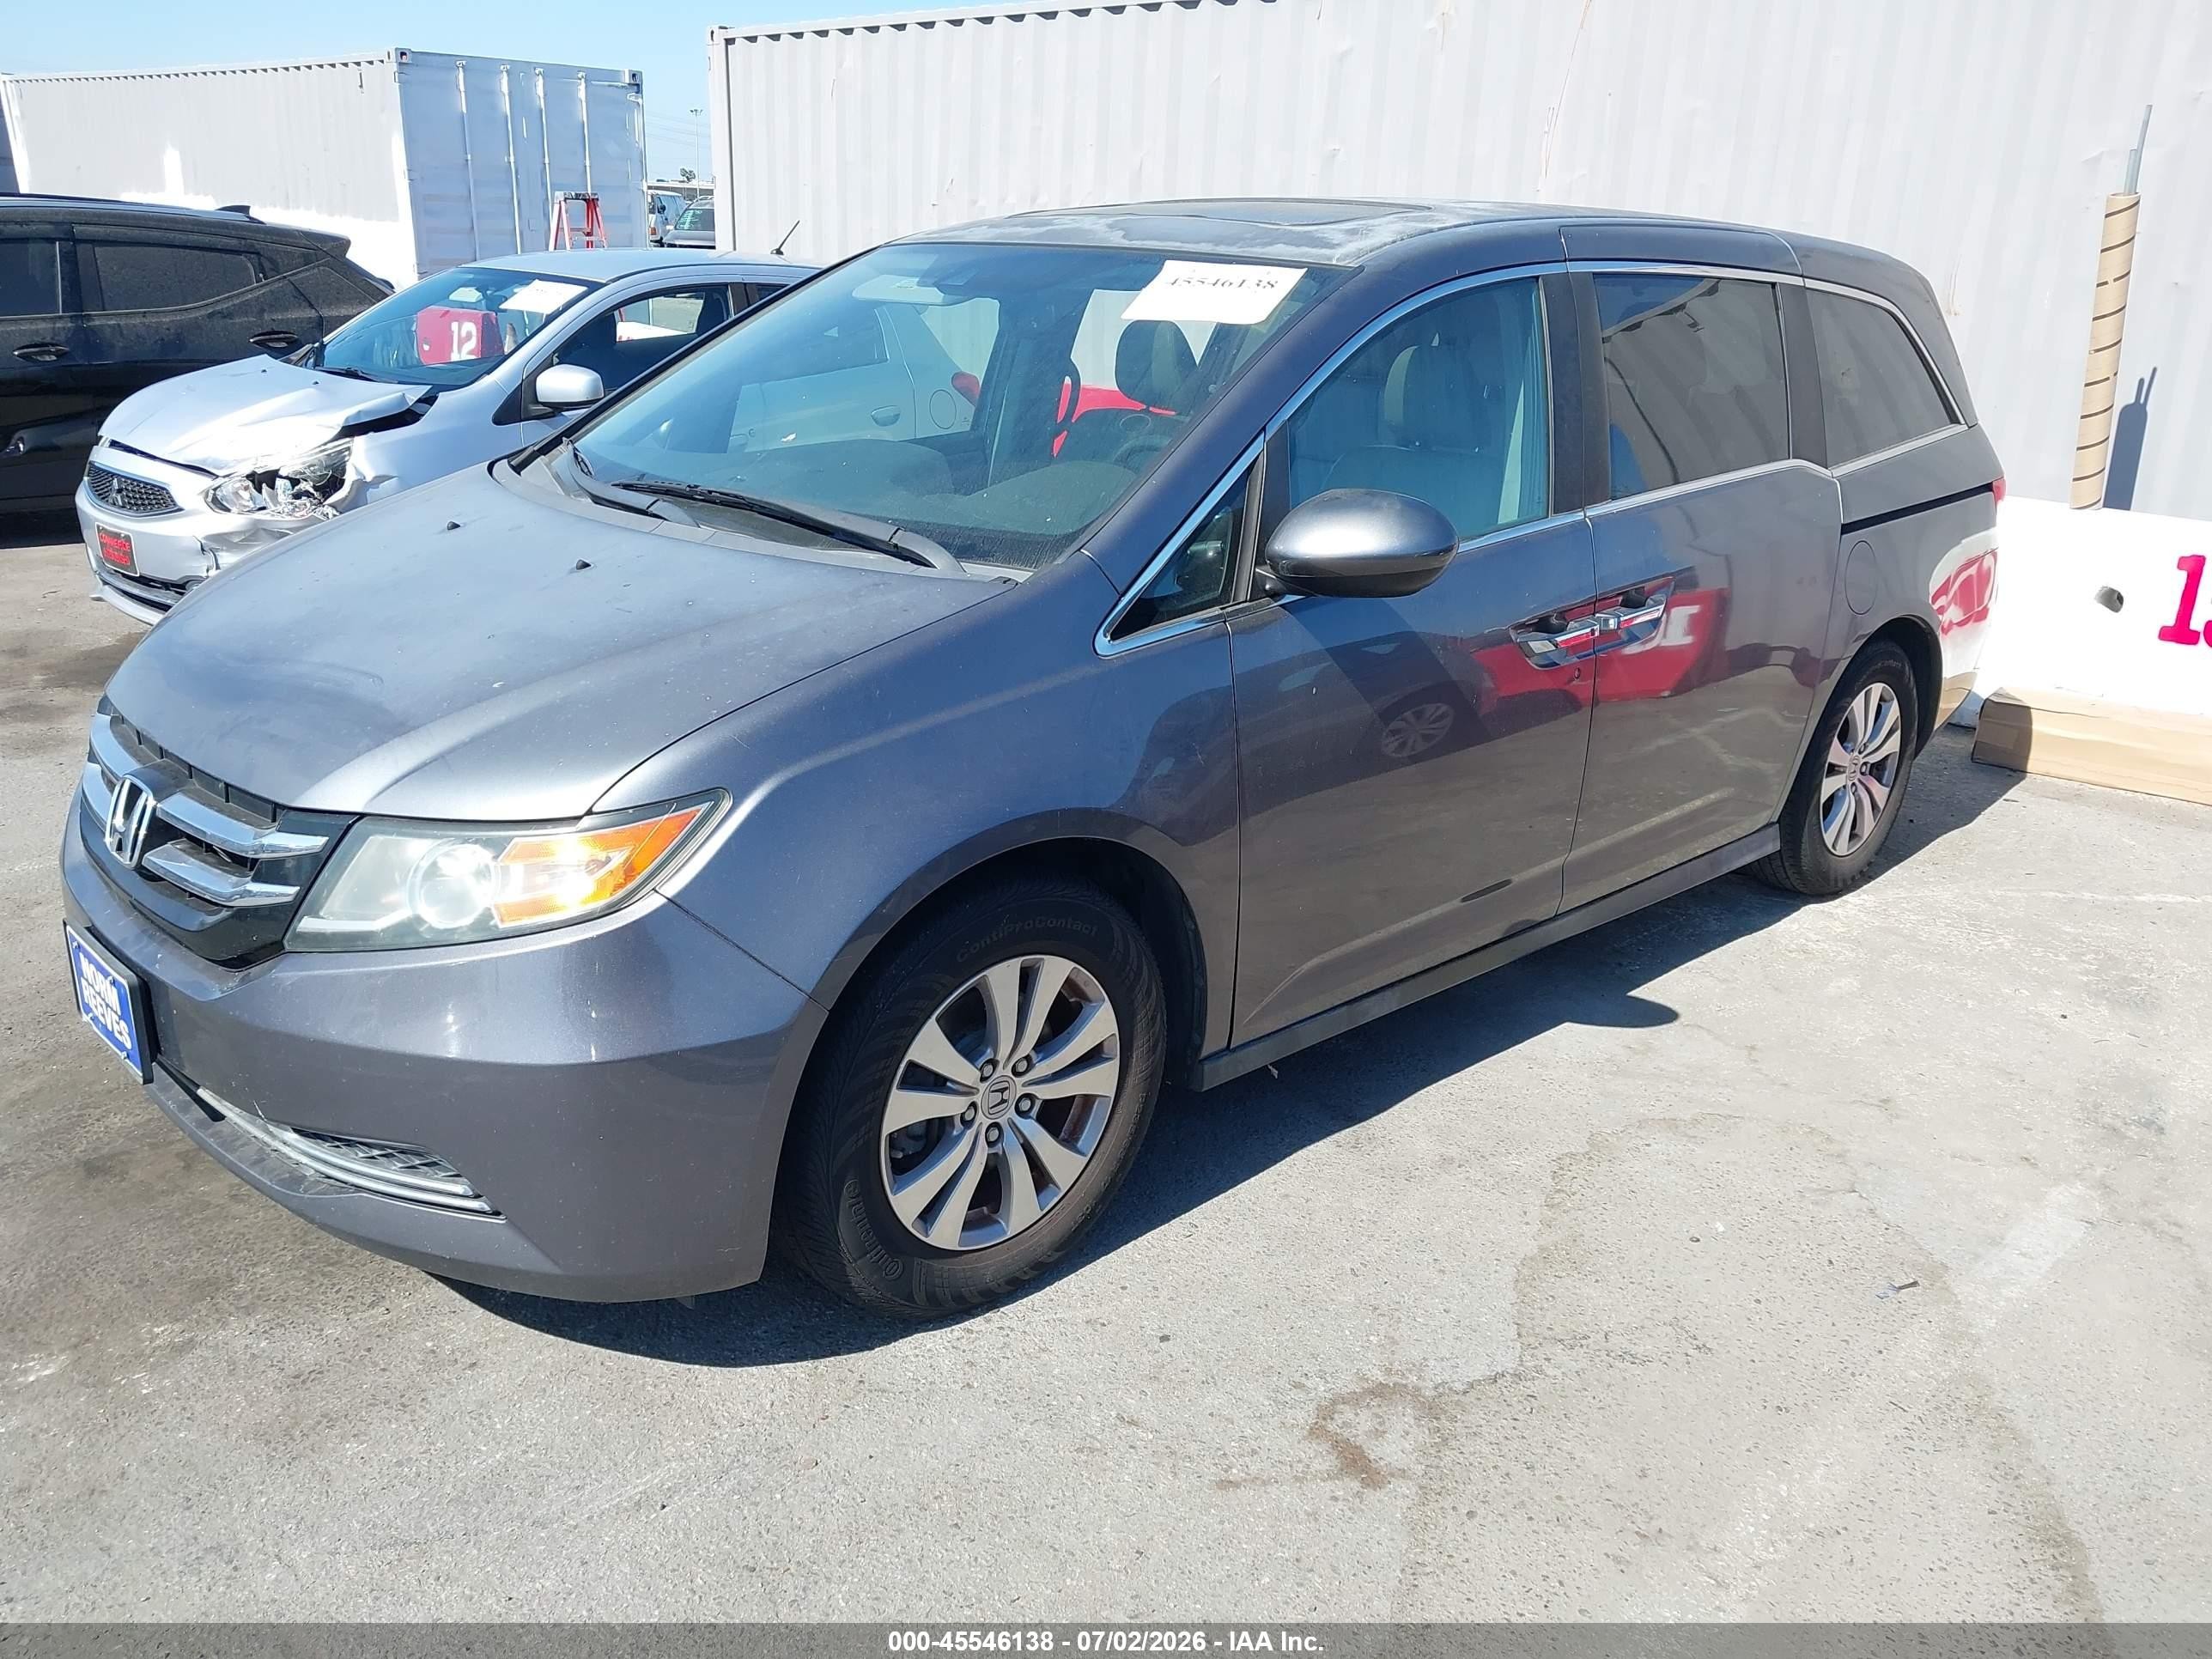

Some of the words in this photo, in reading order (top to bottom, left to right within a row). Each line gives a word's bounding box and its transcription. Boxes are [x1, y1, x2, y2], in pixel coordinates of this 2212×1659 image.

[450, 321, 477, 361] 12
[2158, 554, 2212, 647] 1
[956, 915, 1100, 963] ContiProContact
[79, 952, 122, 1017] NORM
[80, 976, 132, 1050] REEVES
